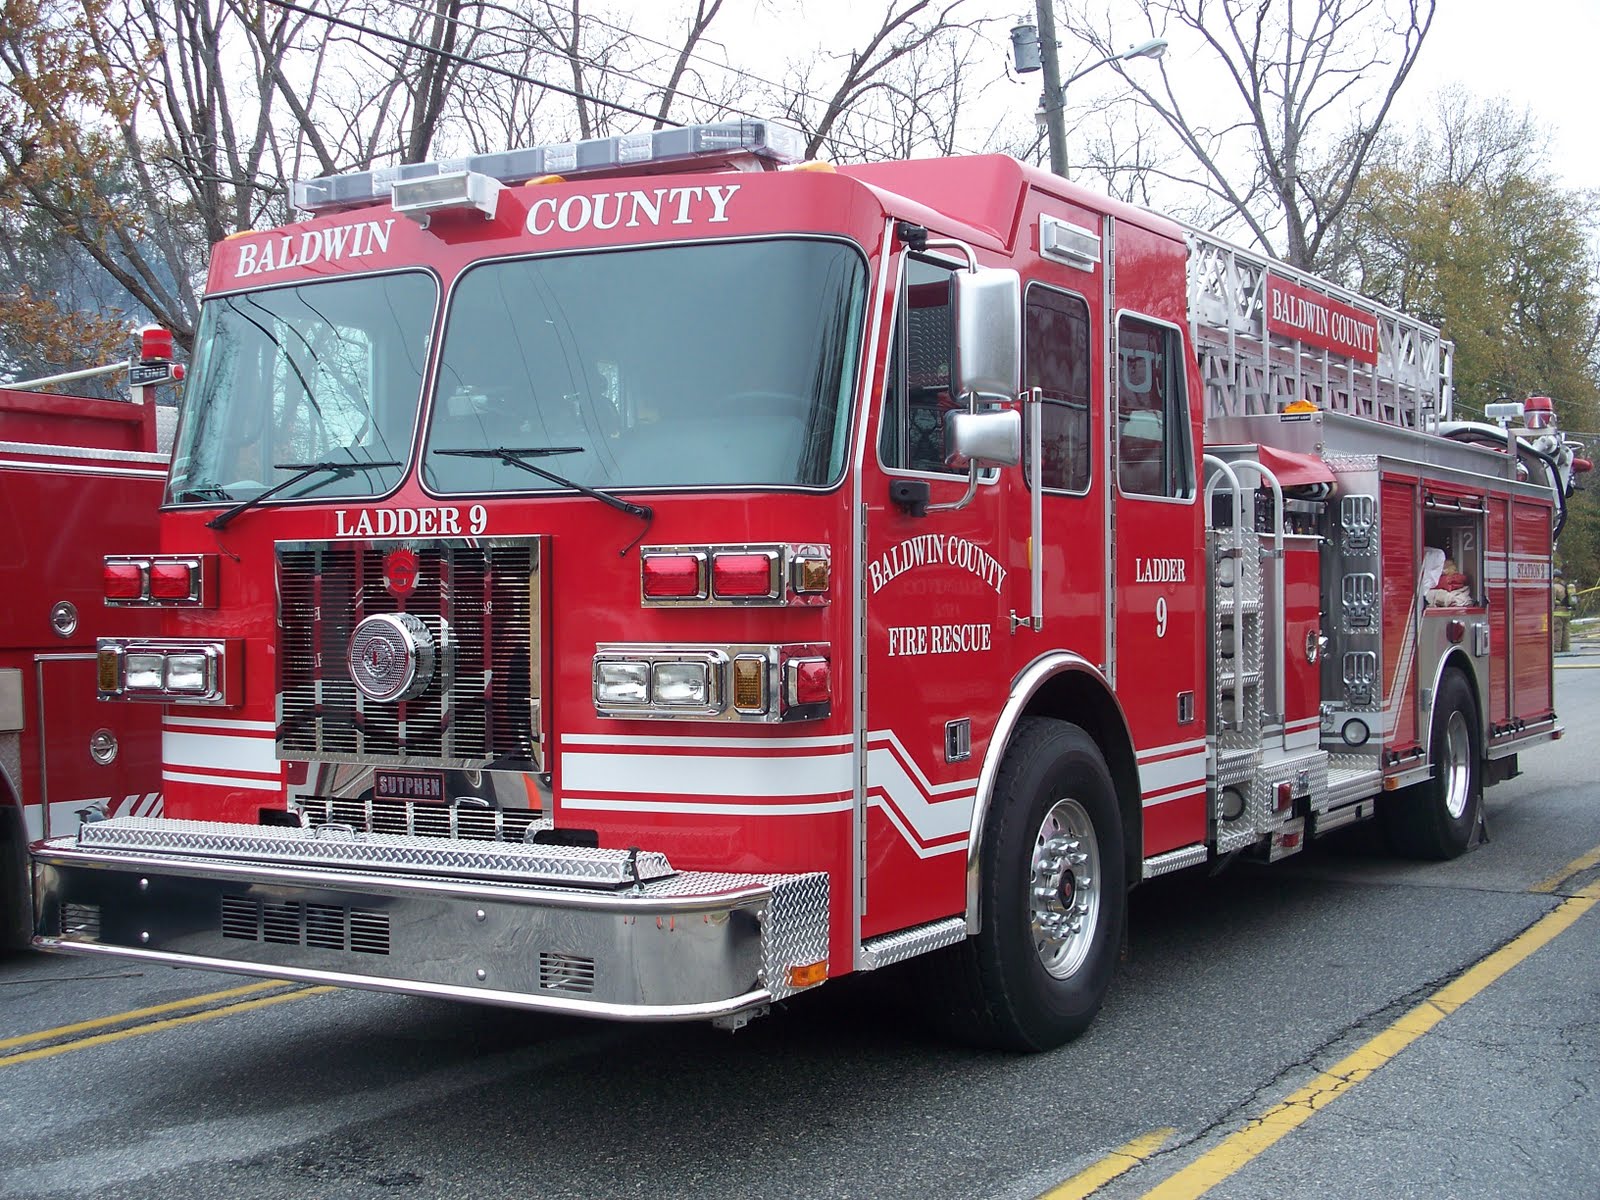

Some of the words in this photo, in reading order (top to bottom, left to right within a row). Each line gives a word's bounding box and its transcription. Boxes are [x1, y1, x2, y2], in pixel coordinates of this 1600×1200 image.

[234, 218, 395, 278] BALDWIN
[525, 184, 741, 236] COUNTY
[1272, 288, 1329, 337] BALDWIN
[1331, 311, 1374, 353] COUNTY
[132, 366, 167, 379] E-ONE
[335, 507, 462, 537] LADDER
[469, 504, 488, 535] 9
[1463, 532, 1474, 550] 2
[868, 533, 945, 594] BALDWIN
[947, 535, 1007, 594] COUNTY
[1135, 558, 1186, 582] LADDER
[1156, 596, 1168, 638] 9
[888, 626, 928, 656] FIRE
[930, 624, 991, 653] RESCUE
[379, 775, 440, 796] SUTPHEN
